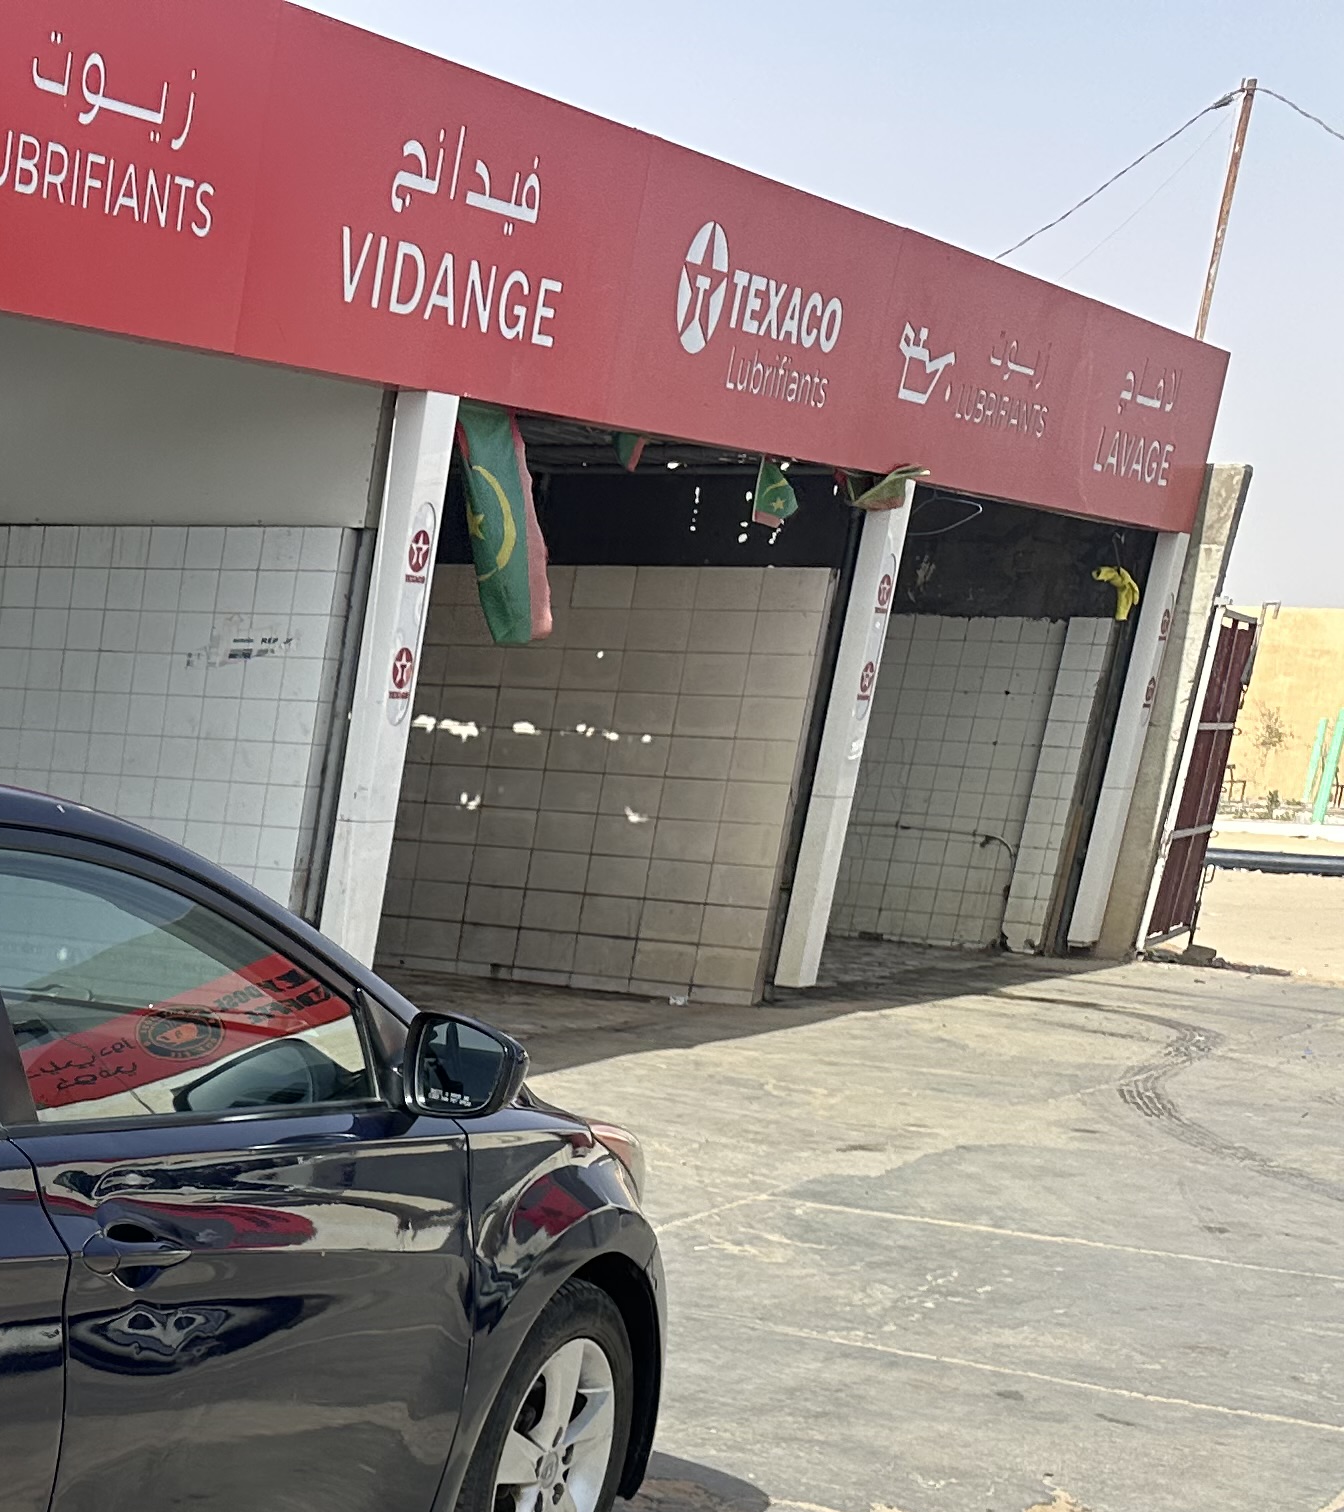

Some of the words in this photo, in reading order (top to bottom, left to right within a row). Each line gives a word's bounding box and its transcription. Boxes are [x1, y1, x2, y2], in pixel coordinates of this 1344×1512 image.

[32, 31, 198, 150] زيوت
[391, 125, 541, 236] فيدانج
[342, 226, 562, 348] VIDANGE
[729, 269, 843, 353] TEXACO
[725, 346, 829, 409] Lubrifiants
[954, 383, 1049, 440] LUBRIFIANTS
[1093, 426, 1174, 486] LAVAGE
